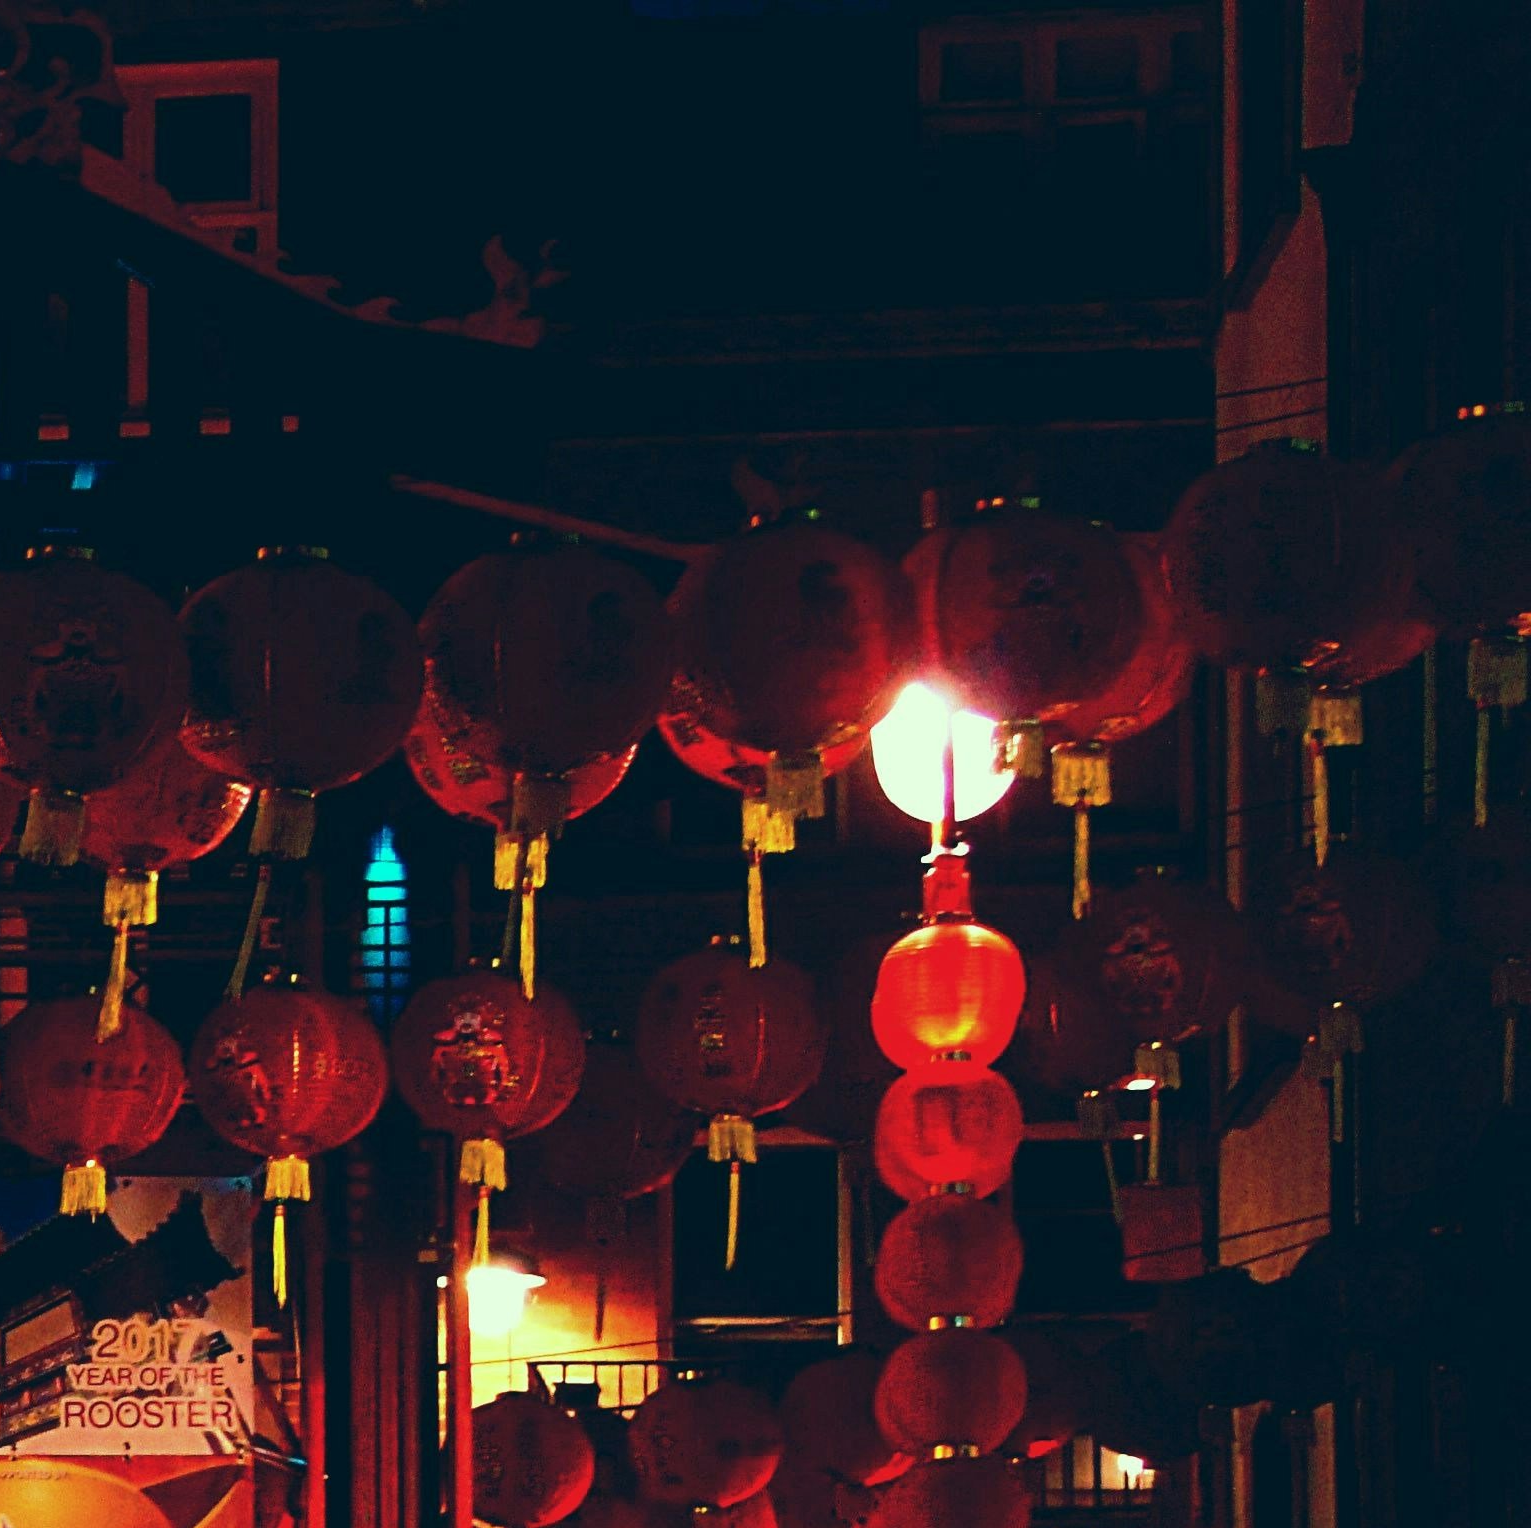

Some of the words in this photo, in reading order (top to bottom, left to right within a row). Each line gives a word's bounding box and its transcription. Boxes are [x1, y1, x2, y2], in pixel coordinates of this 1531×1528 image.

[95, 1322, 196, 1361] 2017
[70, 1367, 133, 1387] YEAR
[139, 1367, 171, 1387] OF
[180, 1366, 225, 1387] THE
[63, 1400, 234, 1429] ROOSTER
